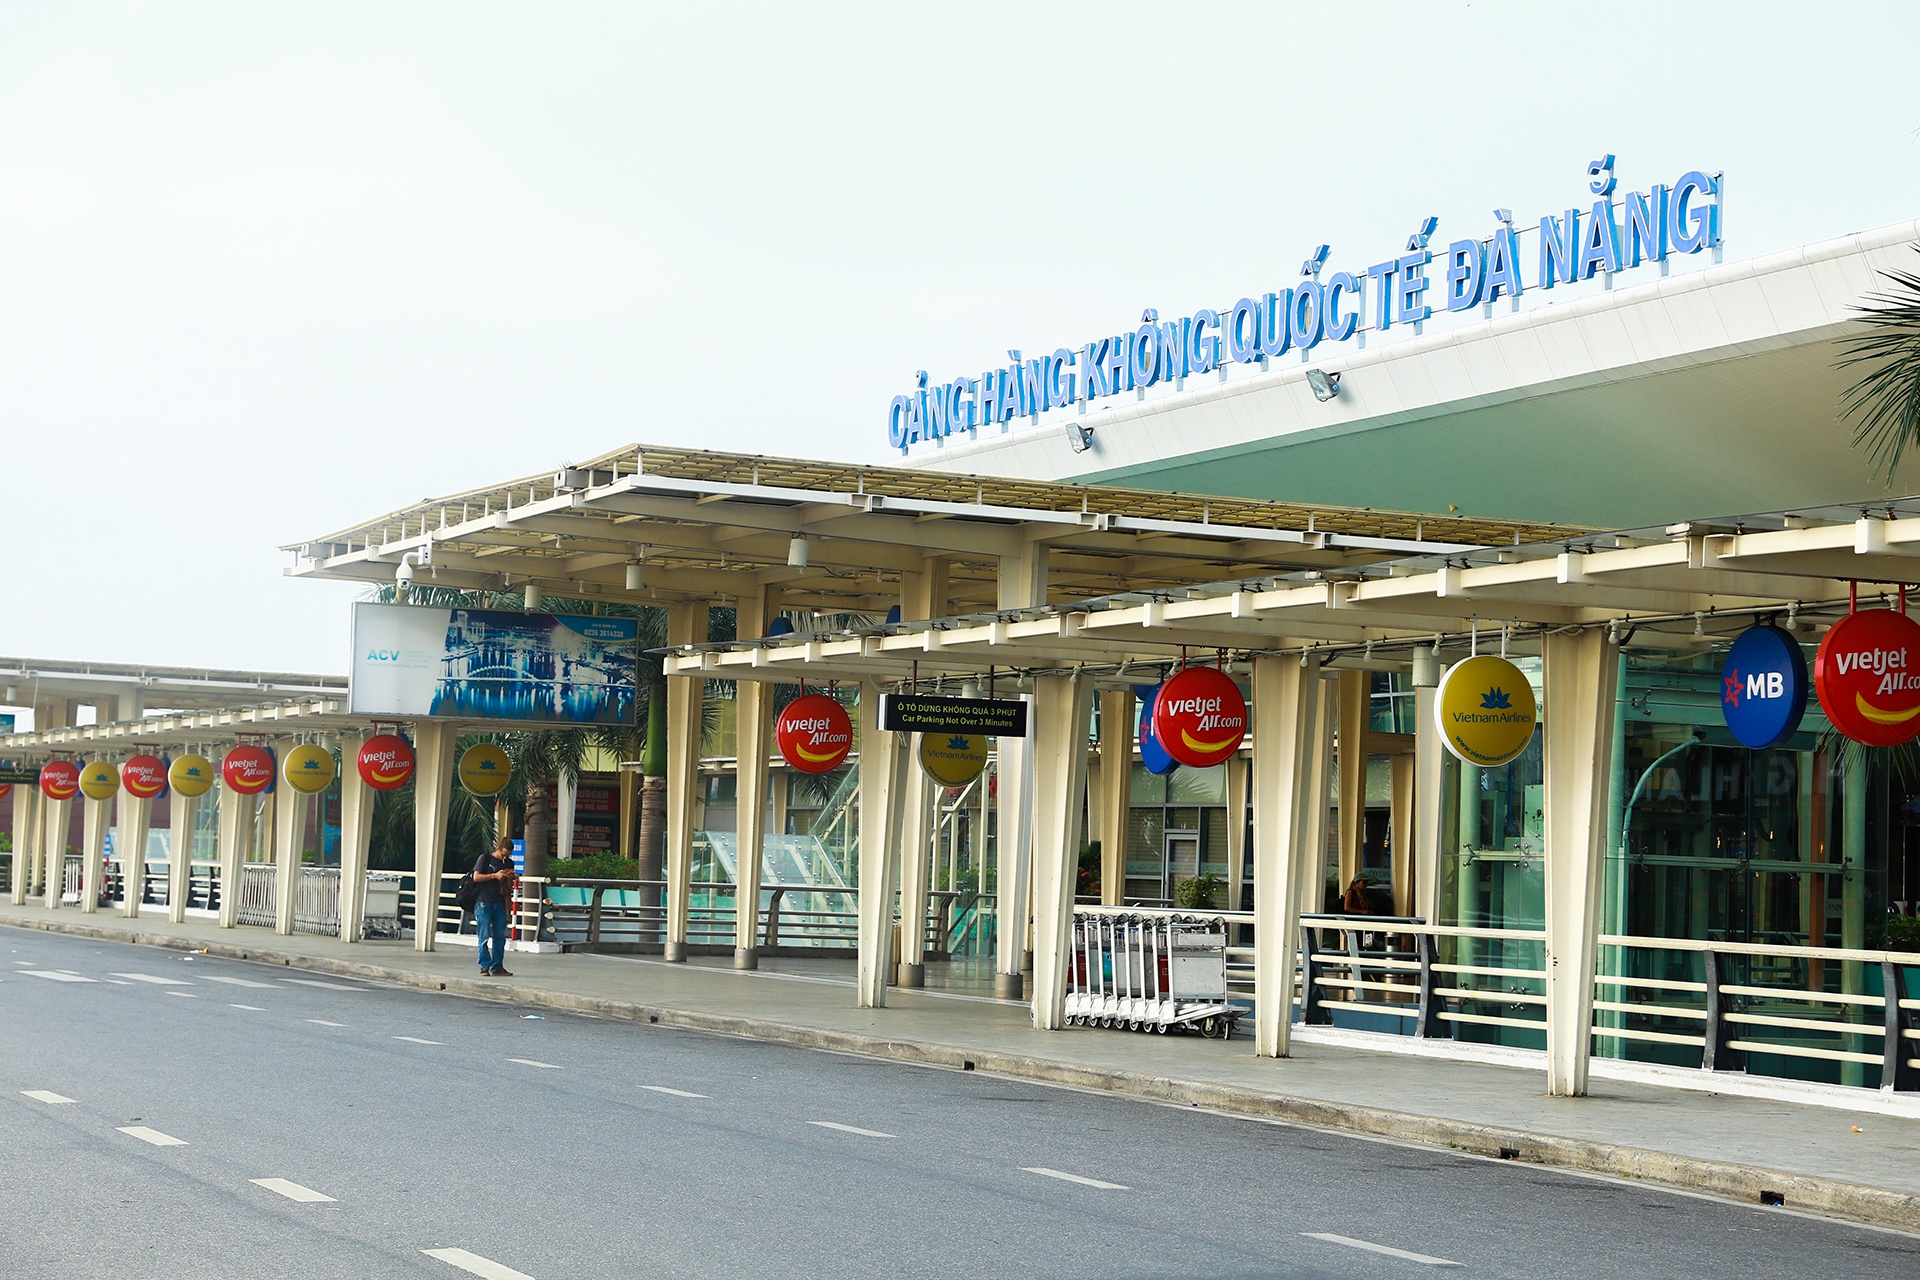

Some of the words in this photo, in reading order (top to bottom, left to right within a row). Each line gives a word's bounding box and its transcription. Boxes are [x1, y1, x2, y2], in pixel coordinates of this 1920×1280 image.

[888, 369, 976, 449] CẢNG
[979, 349, 1075, 427] HÀNG
[1082, 308, 1220, 400] KHÔNG
[1230, 244, 1359, 364] QUỐC
[1368, 216, 1439, 332] TẾ
[1447, 208, 1524, 313] ĐÀ
[1538, 153, 1718, 290] NẴNG
[367, 650, 400, 661] ACV
[1836, 647, 1907, 676] Vietjet
[1746, 672, 1784, 700] MB
[1876, 672, 1920, 695] Air.co
[898, 702, 904, 711] Ô
[906, 702, 917, 712] TÔ
[918, 703, 942, 712] DỪNG
[942, 705, 970, 714] KHÔNG
[973, 706, 989, 716] QUÁ
[996, 708, 1017, 717] PHÚT
[1168, 696, 1222, 717] Vietjet
[902, 714, 915, 722] Car
[916, 715, 944, 725] Parking
[946, 716, 959, 724] Not
[961, 718, 978, 726] Over
[984, 719, 1013, 727] Minutes
[1196, 714, 1242, 732] Air.com
[1452, 712, 1498, 723] Vietnam
[1498, 712, 1532, 723] Airlines
[786, 717, 830, 736] Vietjet
[809, 732, 848, 745] Air.com
[363, 750, 396, 764] Vietjet
[928, 750, 960, 760] Vietnam
[960, 752, 984, 762] Airlines
[1456, 736, 1528, 762] www.vietnamairlines.com
[577, 790, 609, 798] URGER
